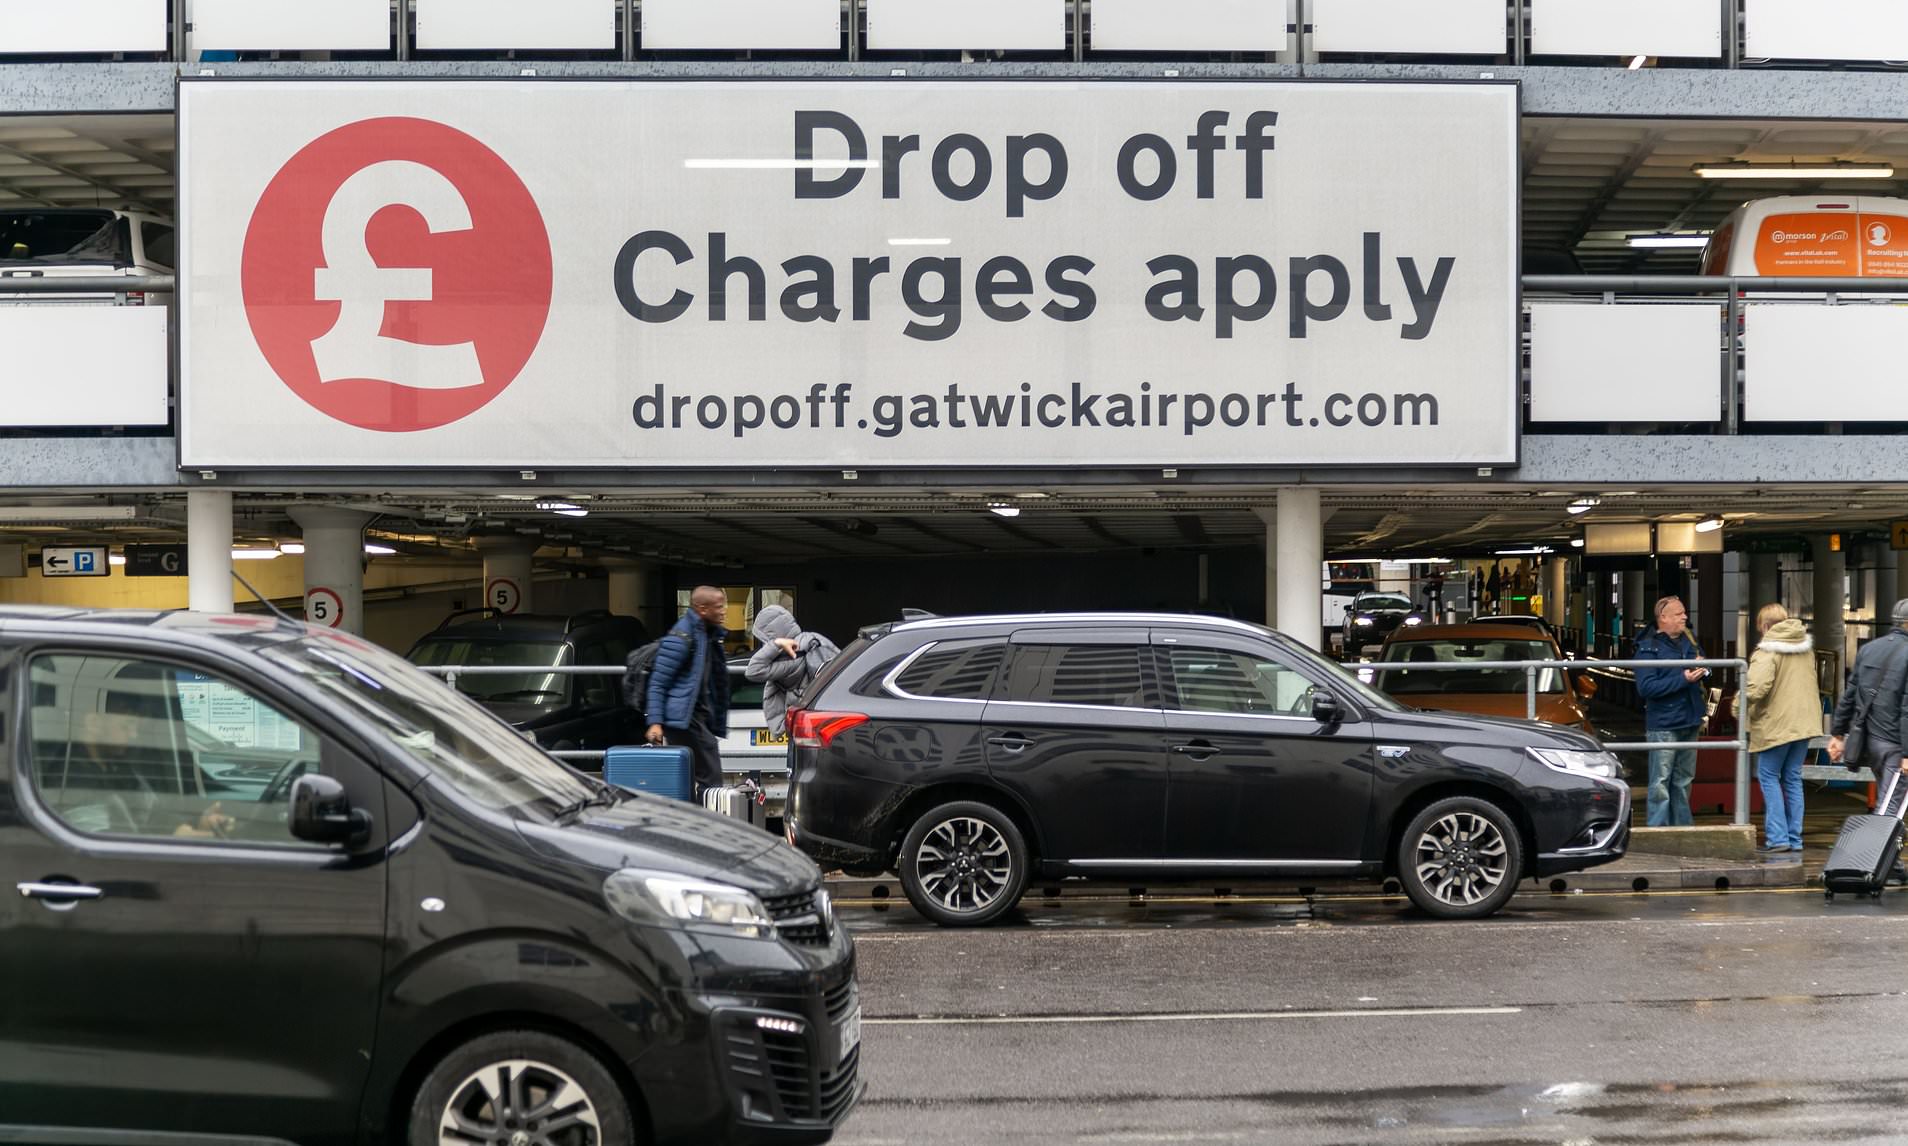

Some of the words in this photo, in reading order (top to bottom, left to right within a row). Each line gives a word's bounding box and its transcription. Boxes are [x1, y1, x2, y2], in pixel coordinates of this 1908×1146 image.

[795, 111, 1069, 218] Drop
[1117, 110, 1279, 201] off
[309, 159, 485, 390] £
[613, 231, 1097, 342] Charges
[1144, 231, 1457, 341] apply
[632, 381, 1440, 438] dropoff.gatwickairport.com
[80, 554, 92, 570] P
[161, 552, 179, 572] G
[314, 601, 327, 620] 5
[497, 590, 508, 605] 5
